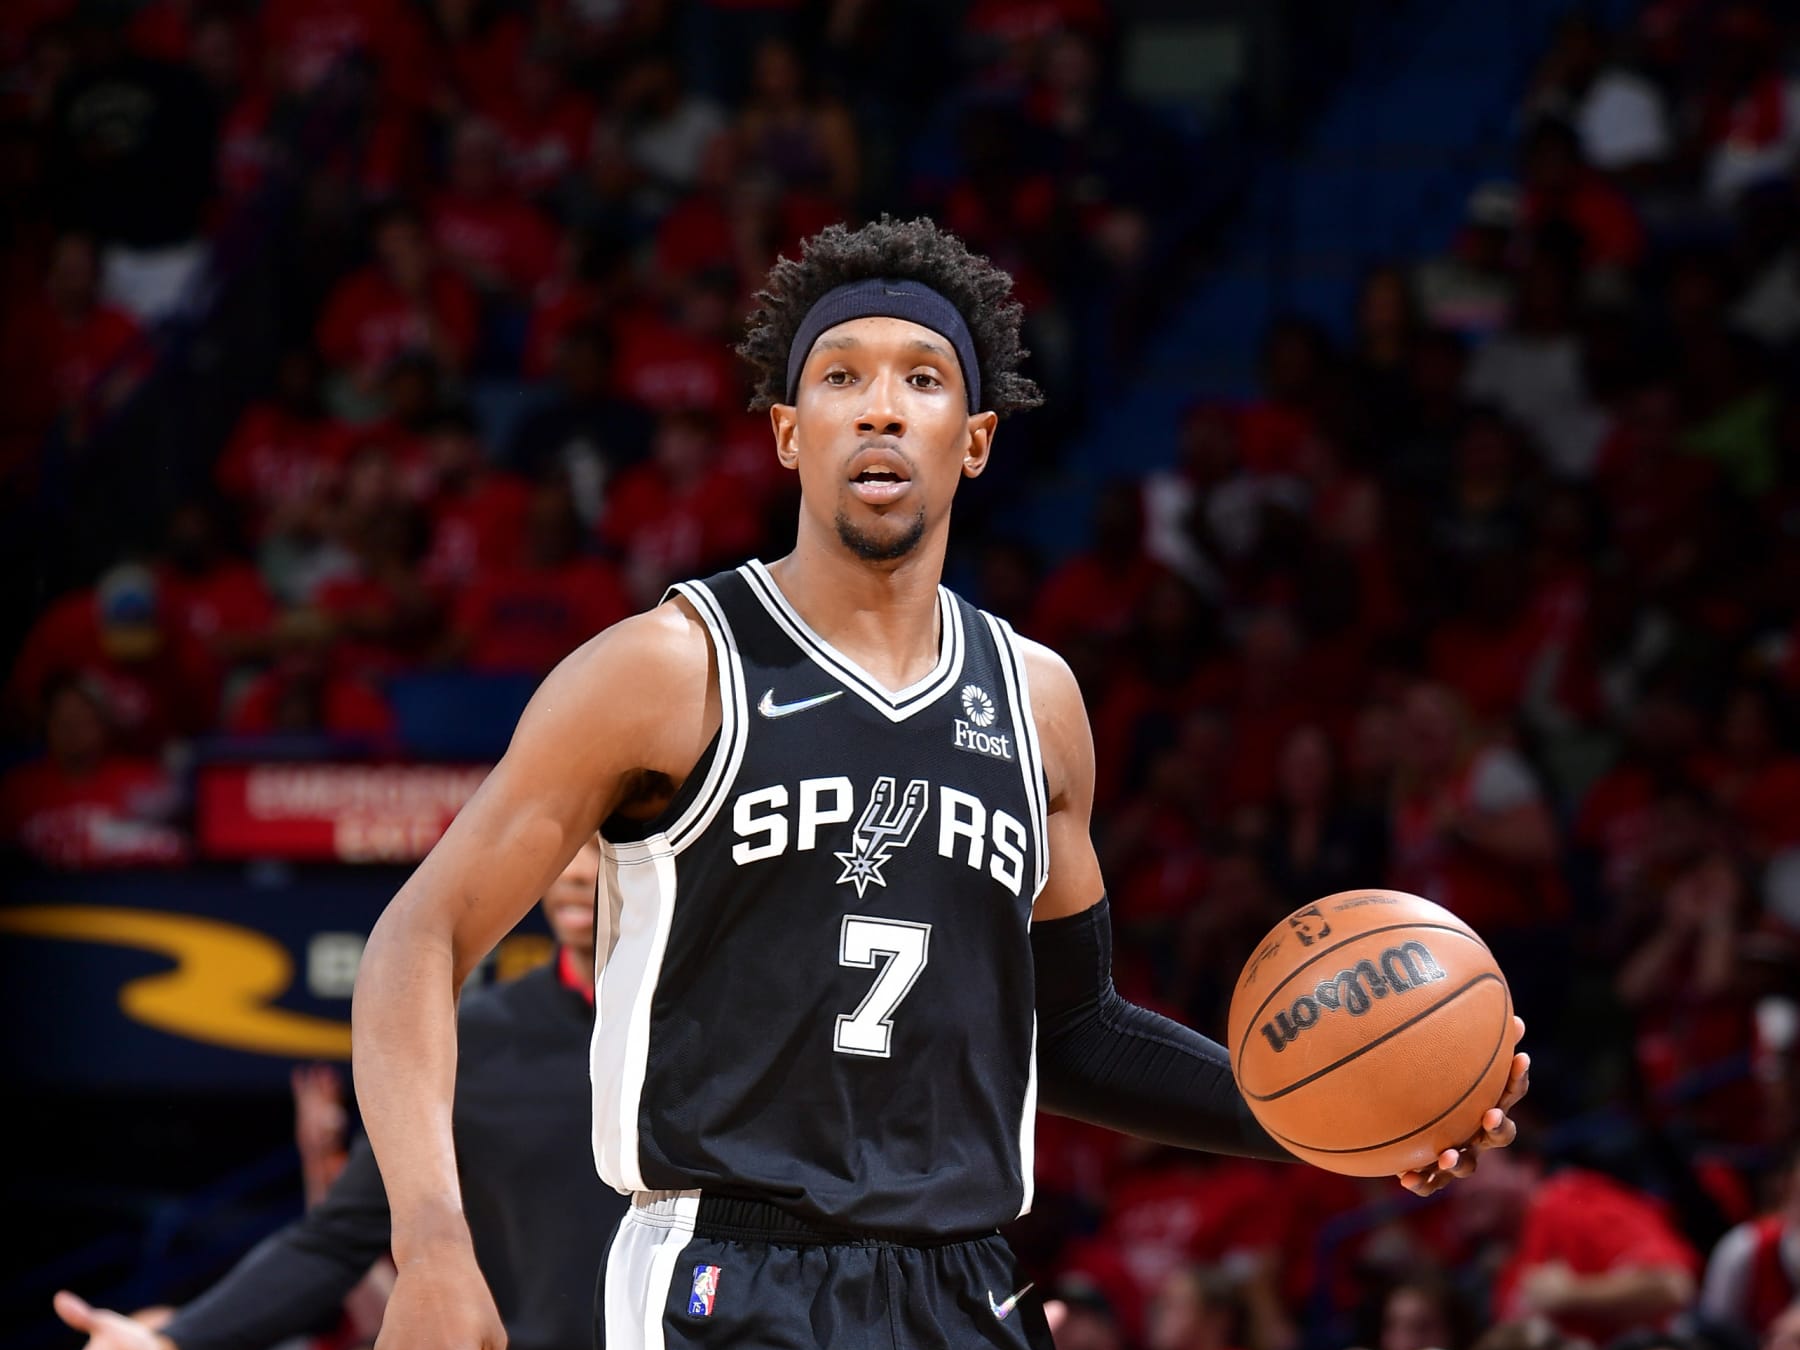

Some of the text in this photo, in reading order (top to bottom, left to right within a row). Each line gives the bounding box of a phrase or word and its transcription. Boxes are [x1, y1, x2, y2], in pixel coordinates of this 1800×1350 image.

[953, 719, 1011, 759] Frost
[732, 776, 1027, 898] SPURS
[833, 914, 932, 1058] 7
[1260, 940, 1447, 1053] Wilson
